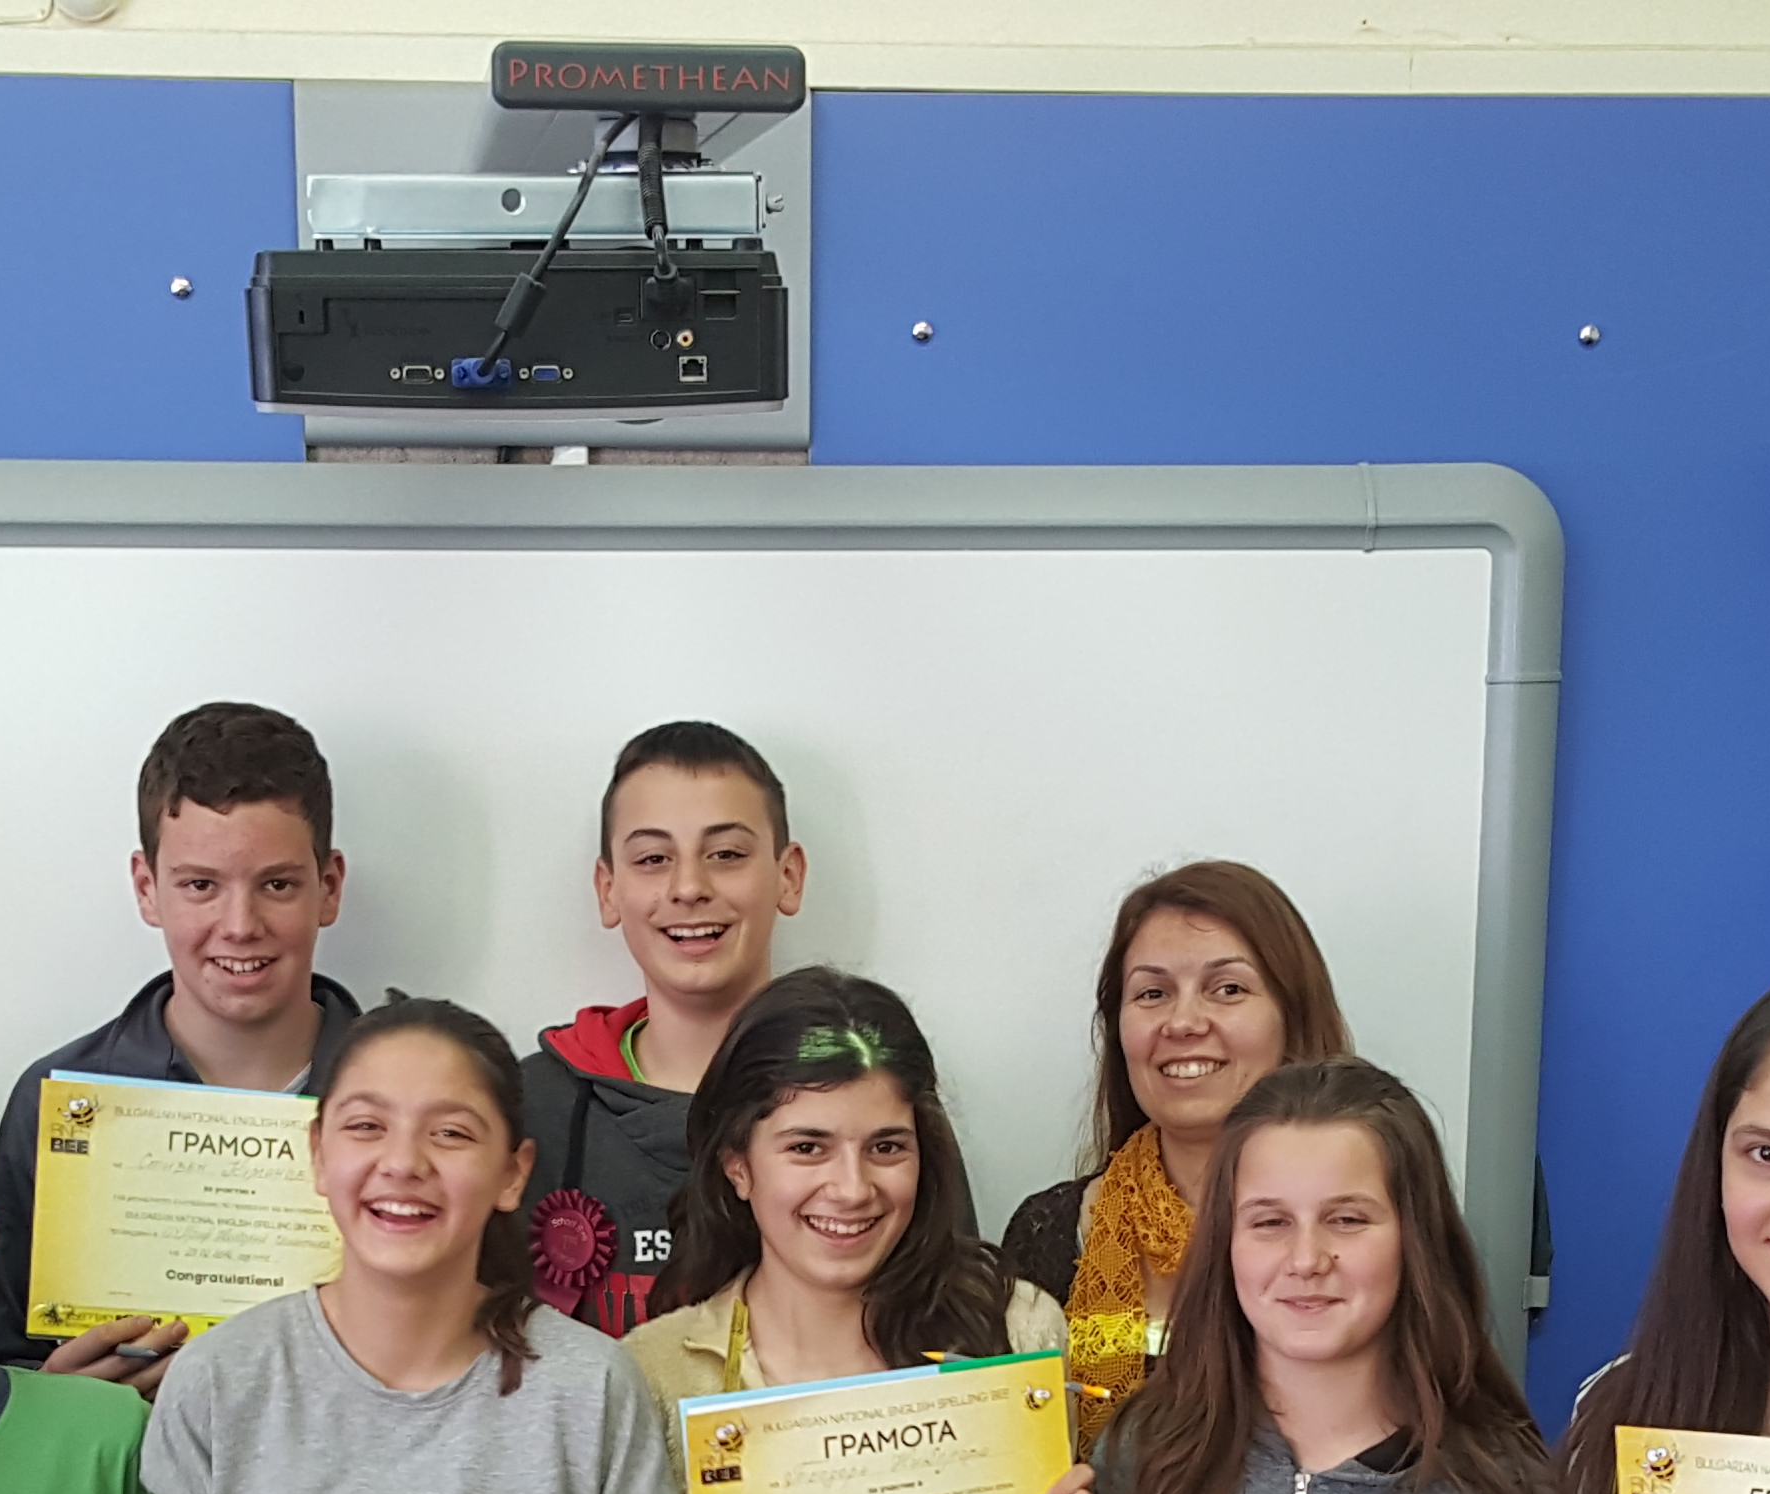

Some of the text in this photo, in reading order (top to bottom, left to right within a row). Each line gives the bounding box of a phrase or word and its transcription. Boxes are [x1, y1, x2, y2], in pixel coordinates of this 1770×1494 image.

[509, 59, 790, 92] PROMETHEAN
[169, 1131, 295, 1160] ГРАМОТА
[166, 1270, 284, 1287] Congratulations!
[823, 1420, 957, 1459] ГРАМОТА
